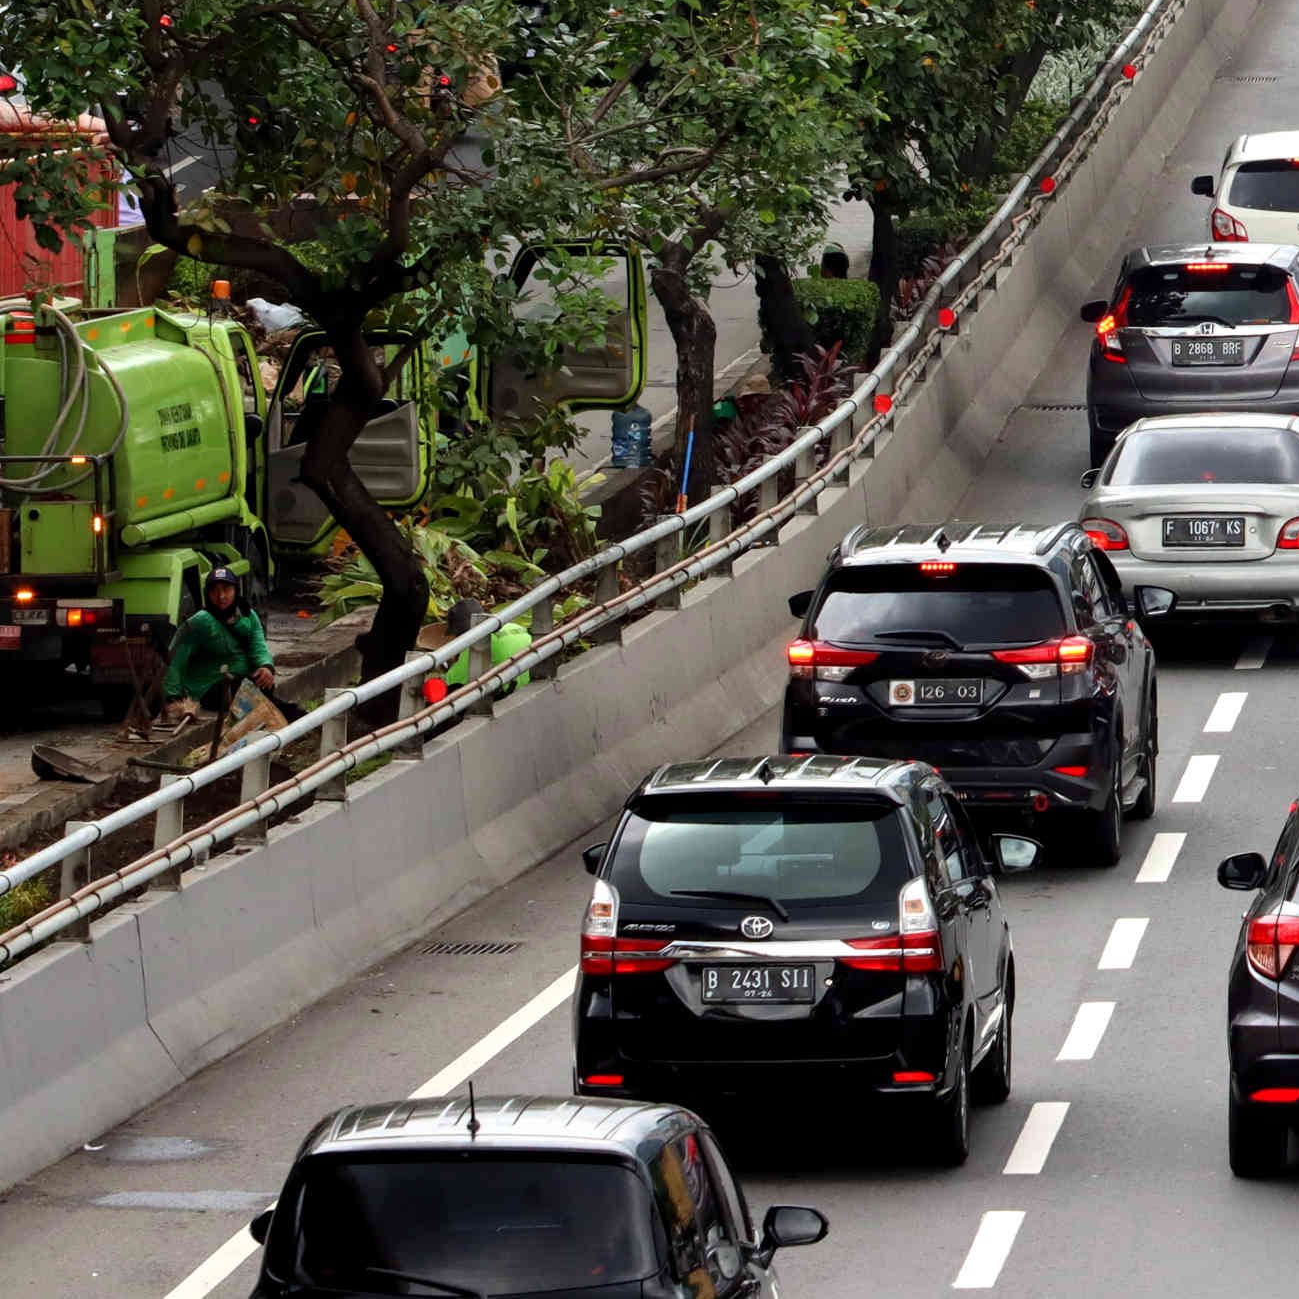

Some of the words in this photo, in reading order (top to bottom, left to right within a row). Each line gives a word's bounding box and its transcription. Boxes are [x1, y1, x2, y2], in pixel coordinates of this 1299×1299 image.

[1174, 343, 1181, 355] B
[1188, 343, 1213, 355] 2868
[1166, 521, 1174, 535] F
[1188, 521, 1216, 535] 1067
[1226, 521, 1241, 535] KS
[958, 684, 977, 698] 03
[708, 970, 718, 988] B
[732, 970, 770, 988] 2431
[781, 970, 809, 988] SII
